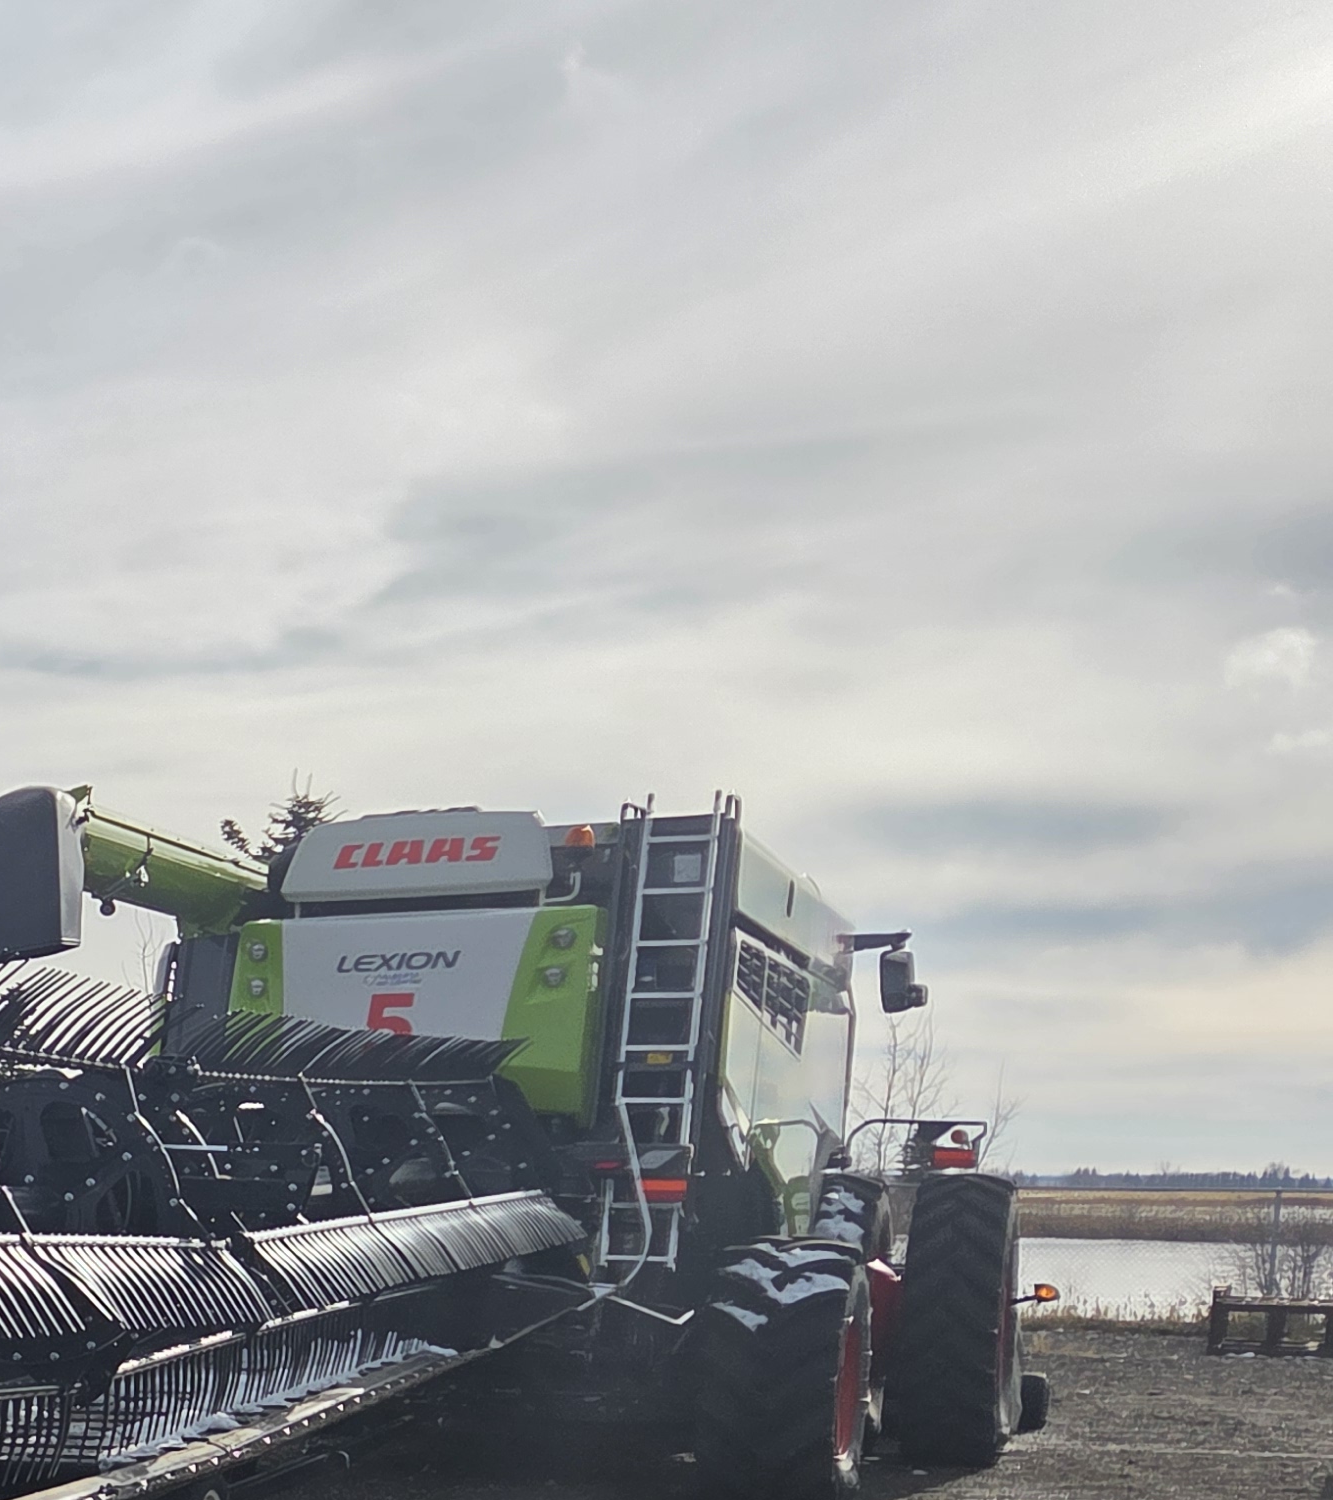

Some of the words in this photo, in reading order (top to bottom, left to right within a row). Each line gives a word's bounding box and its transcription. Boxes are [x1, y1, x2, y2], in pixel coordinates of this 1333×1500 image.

[333, 836, 502, 870] CLAAS
[336, 950, 462, 973] LEXION
[366, 992, 415, 1036] 5
